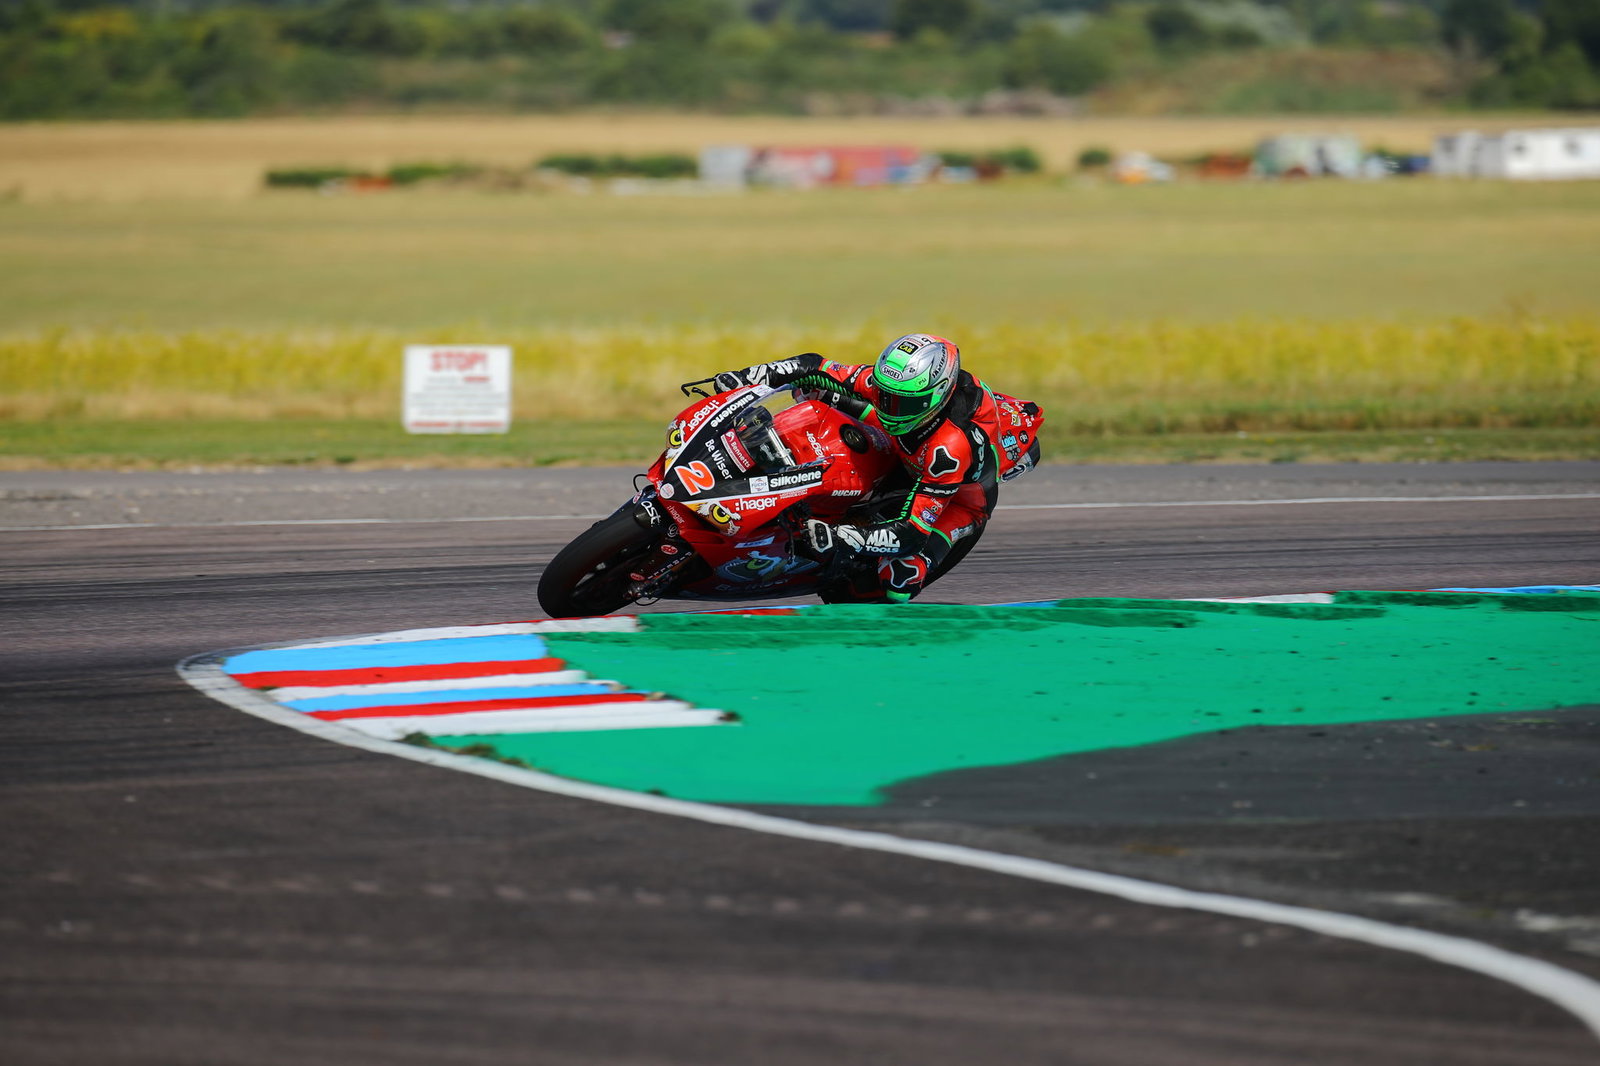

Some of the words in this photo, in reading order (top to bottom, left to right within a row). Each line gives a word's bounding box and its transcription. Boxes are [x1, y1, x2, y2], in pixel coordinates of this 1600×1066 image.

[883, 366, 900, 379] SHOEI
[705, 439, 716, 452] Be
[711, 448, 733, 480] Wiser
[731, 441, 750, 468] Bennetts
[674, 460, 716, 496] 2
[866, 528, 900, 548] MAC
